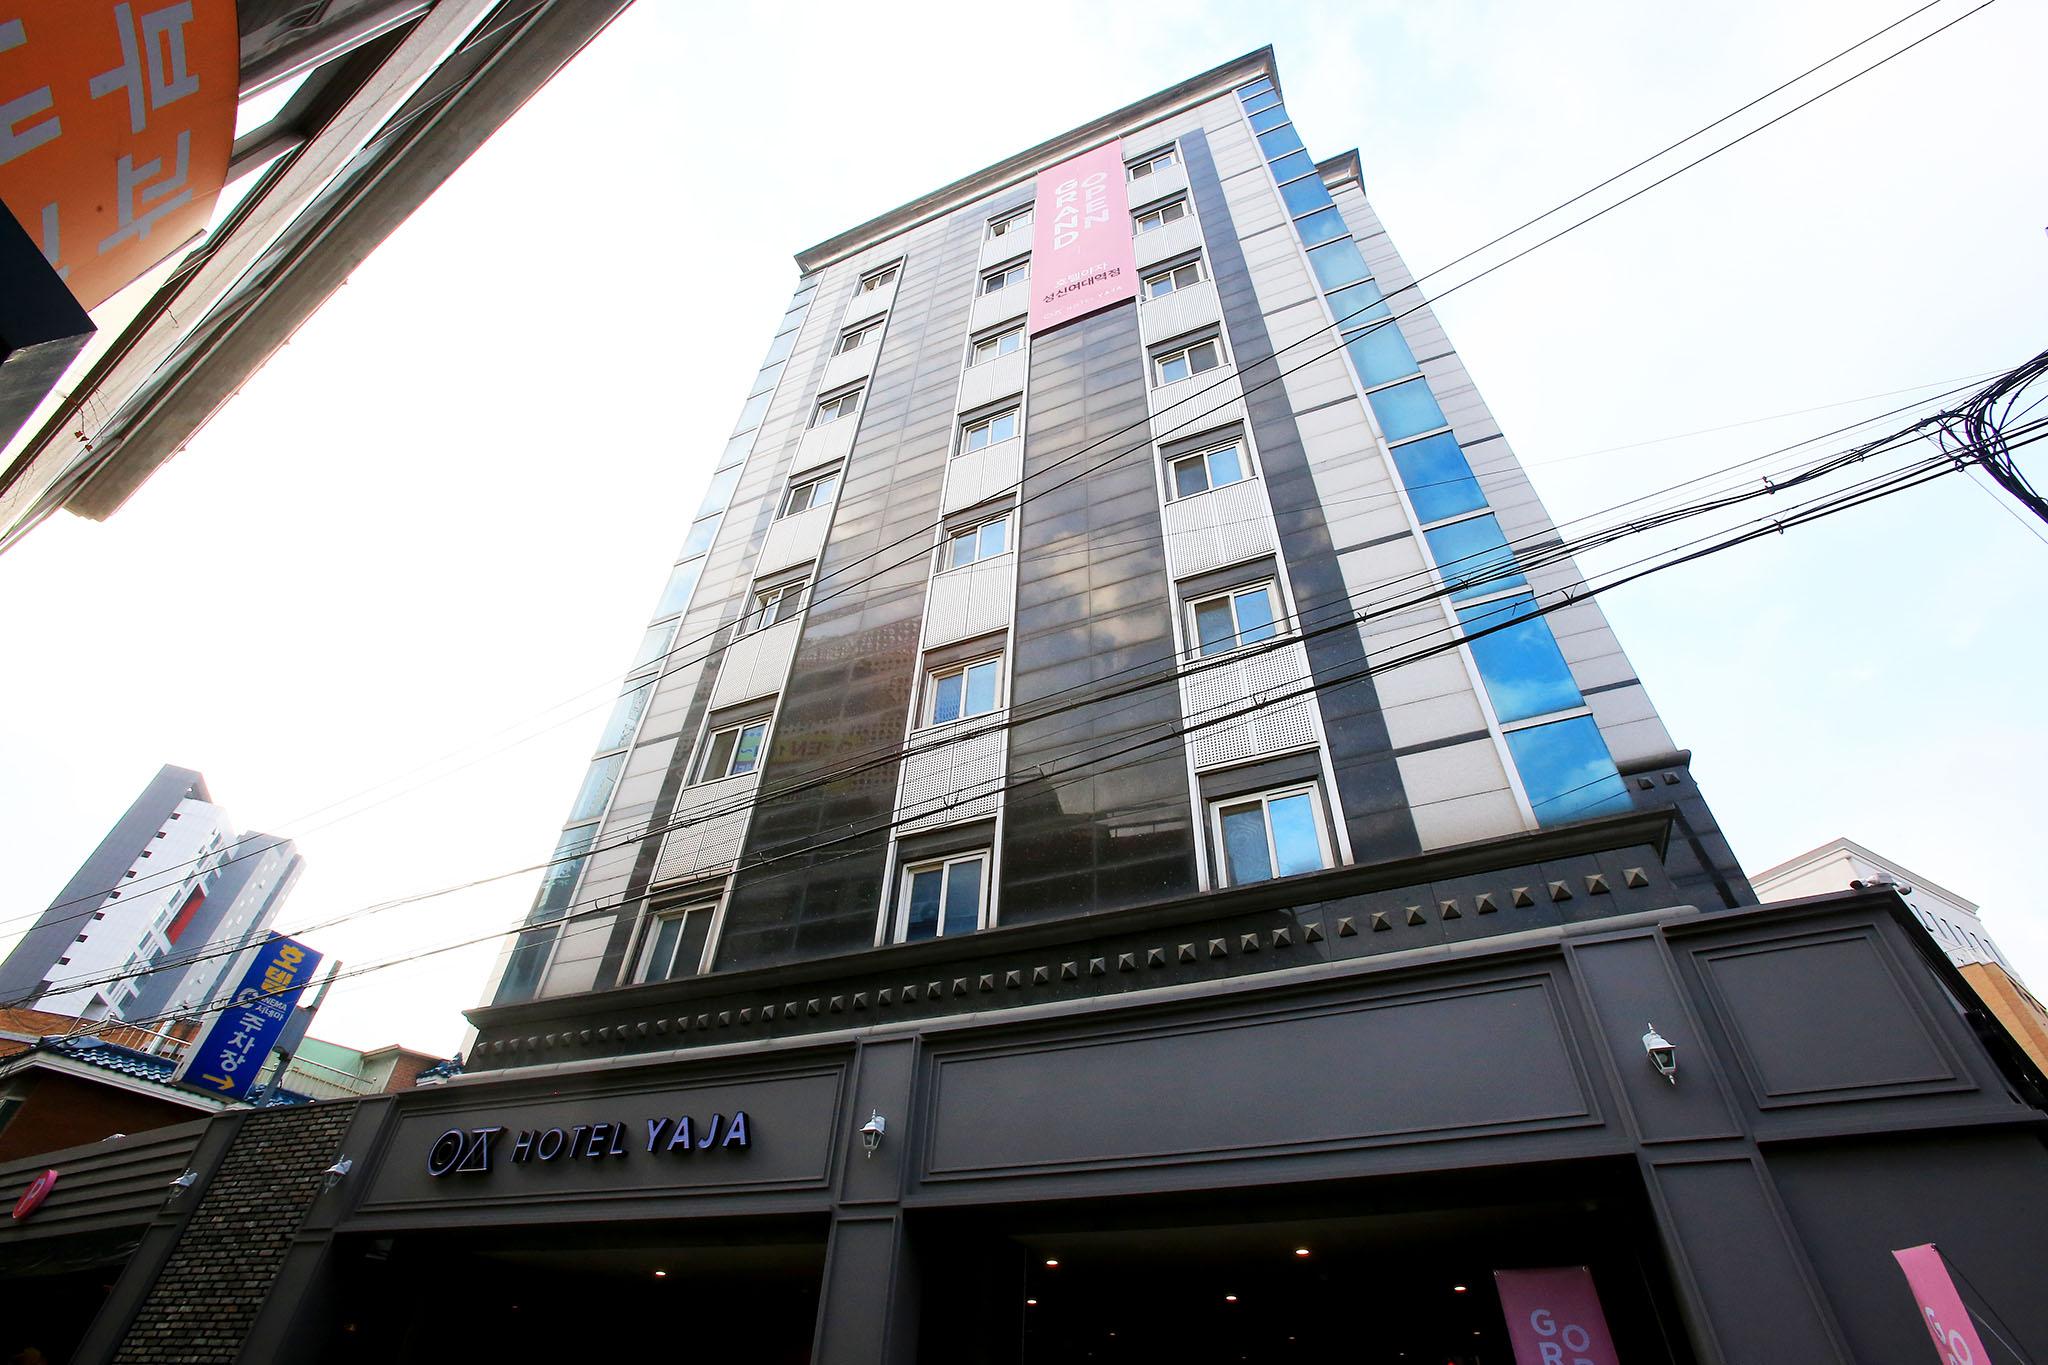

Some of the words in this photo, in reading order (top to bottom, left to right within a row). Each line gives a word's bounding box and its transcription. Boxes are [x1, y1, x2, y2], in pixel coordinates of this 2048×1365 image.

[1054, 178, 1080, 250] GRAND
[1081, 172, 1110, 230] OPEN
[1043, 267, 1121, 303] 성신여대역점
[260, 943, 306, 999] 호텔
[219, 1012, 267, 1072] 주차장
[510, 1121, 628, 1163] HOTEL
[646, 1110, 752, 1153] YAJA
